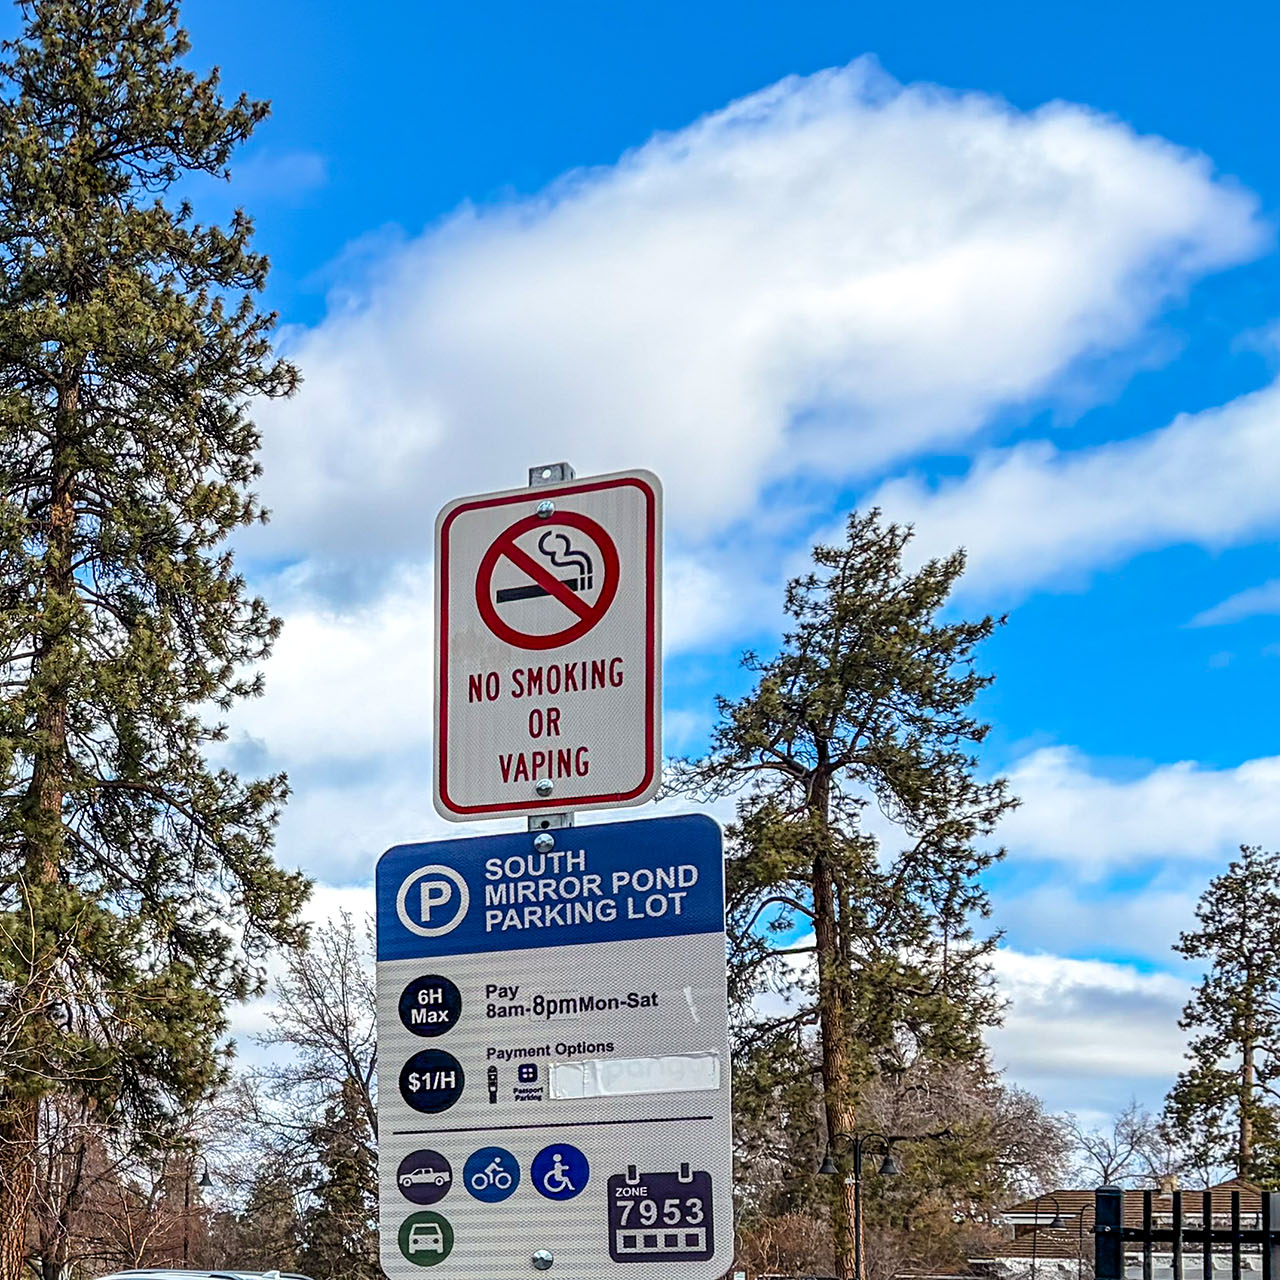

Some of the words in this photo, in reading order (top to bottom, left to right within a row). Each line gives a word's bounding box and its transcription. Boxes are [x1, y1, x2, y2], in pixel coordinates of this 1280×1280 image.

[468, 671, 500, 703] NO
[511, 656, 624, 699] SMOKING
[528, 706, 561, 738] OR
[498, 746, 590, 783] VAPING
[484, 850, 586, 880] SOUTH
[484, 874, 603, 906] MIRROR
[612, 864, 699, 895] POND
[419, 880, 452, 922] P
[485, 898, 618, 932] PARKING
[627, 891, 688, 920] LOT
[417, 988, 443, 1005] 6H
[485, 984, 520, 1001] Pay
[410, 1007, 450, 1024] Max
[486, 1044, 551, 1062] Payment
[554, 1041, 615, 1059] Options
[407, 1071, 456, 1093] $1/H
[615, 1186, 648, 1197] ZONE
[617, 1198, 705, 1226] 7953
